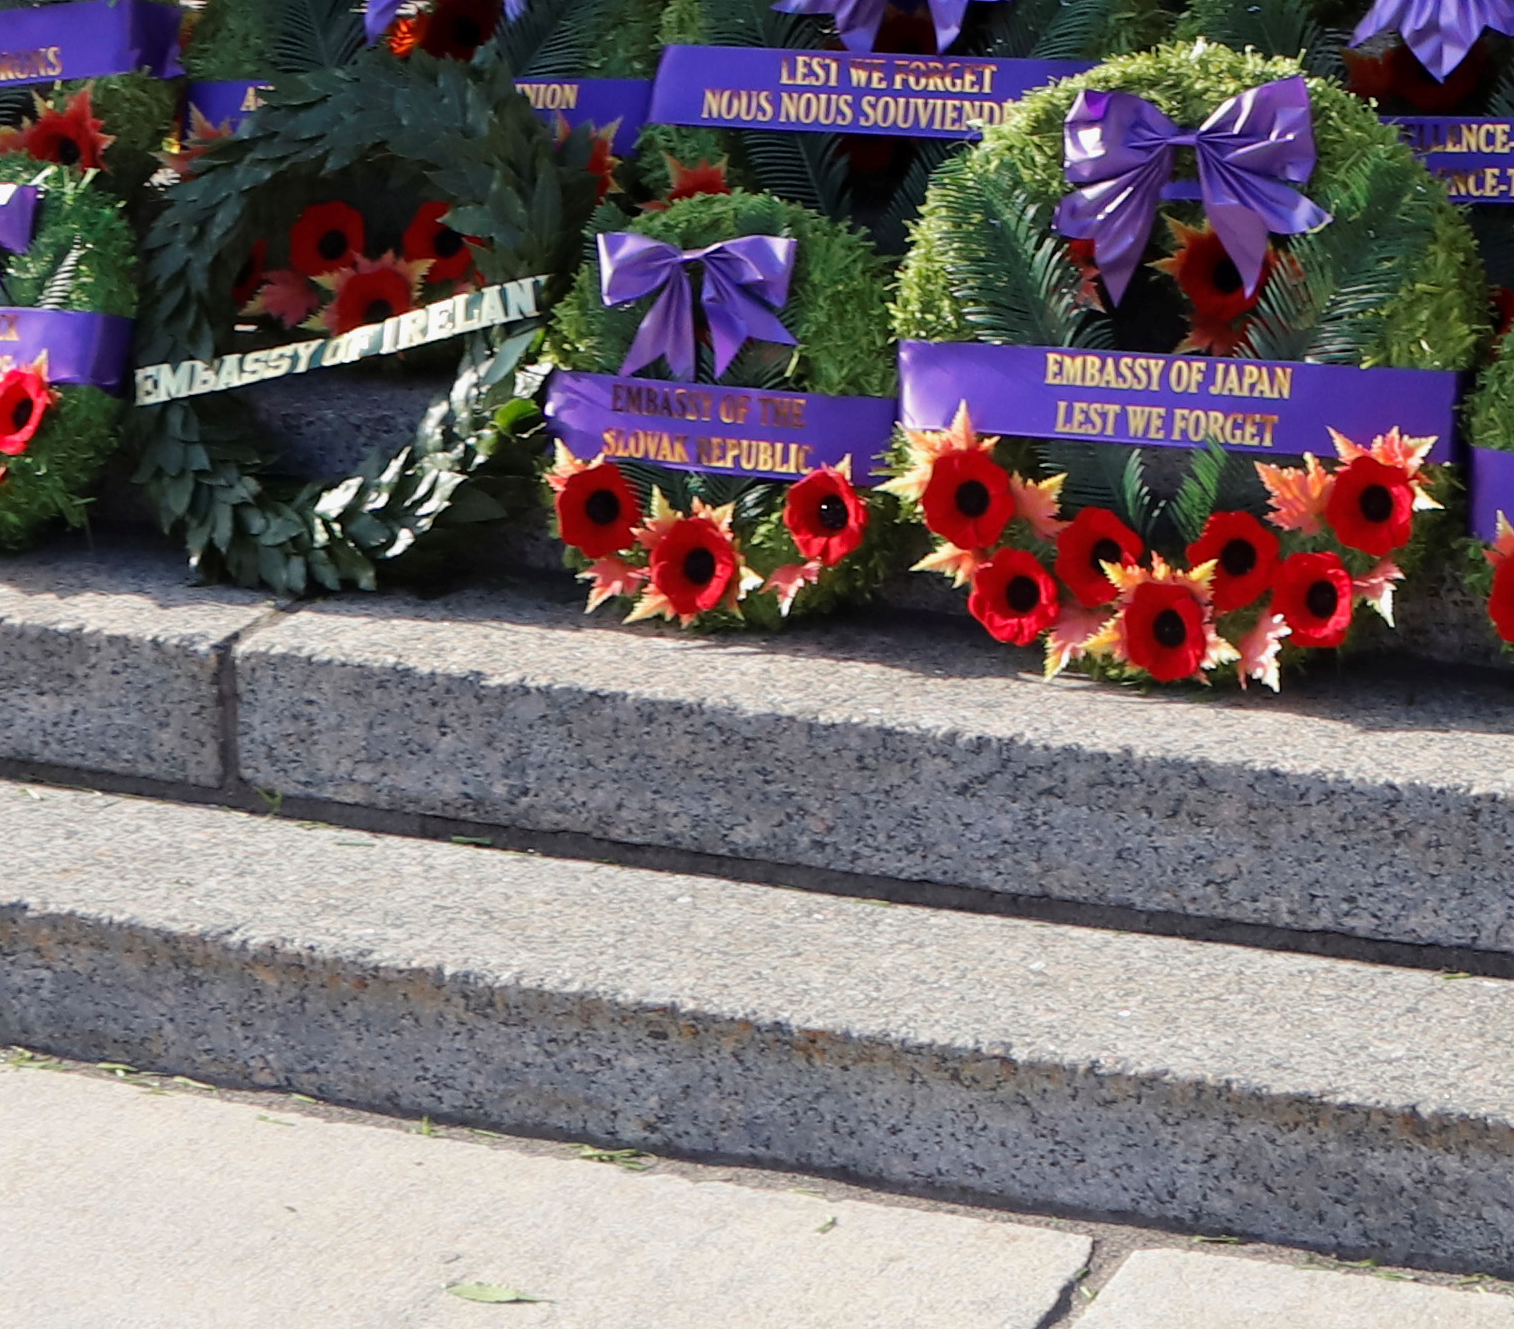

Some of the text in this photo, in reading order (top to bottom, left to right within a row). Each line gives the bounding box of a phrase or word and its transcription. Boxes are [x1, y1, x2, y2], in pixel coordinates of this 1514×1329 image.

[780, 55, 998, 94] LEST WE FORGET
[701, 88, 774, 122] NOUS
[778, 91, 854, 126] NOUS
[134, 274, 555, 407] EMBASSY OF IRELAN
[1044, 352, 1293, 400] EMBASSY OF JAPAN
[611, 384, 807, 429] EMBASSY OF THE
[1054, 401, 1279, 447] LEST WE FORGET
[602, 427, 814, 475] SLOVAK REPUBLIC
